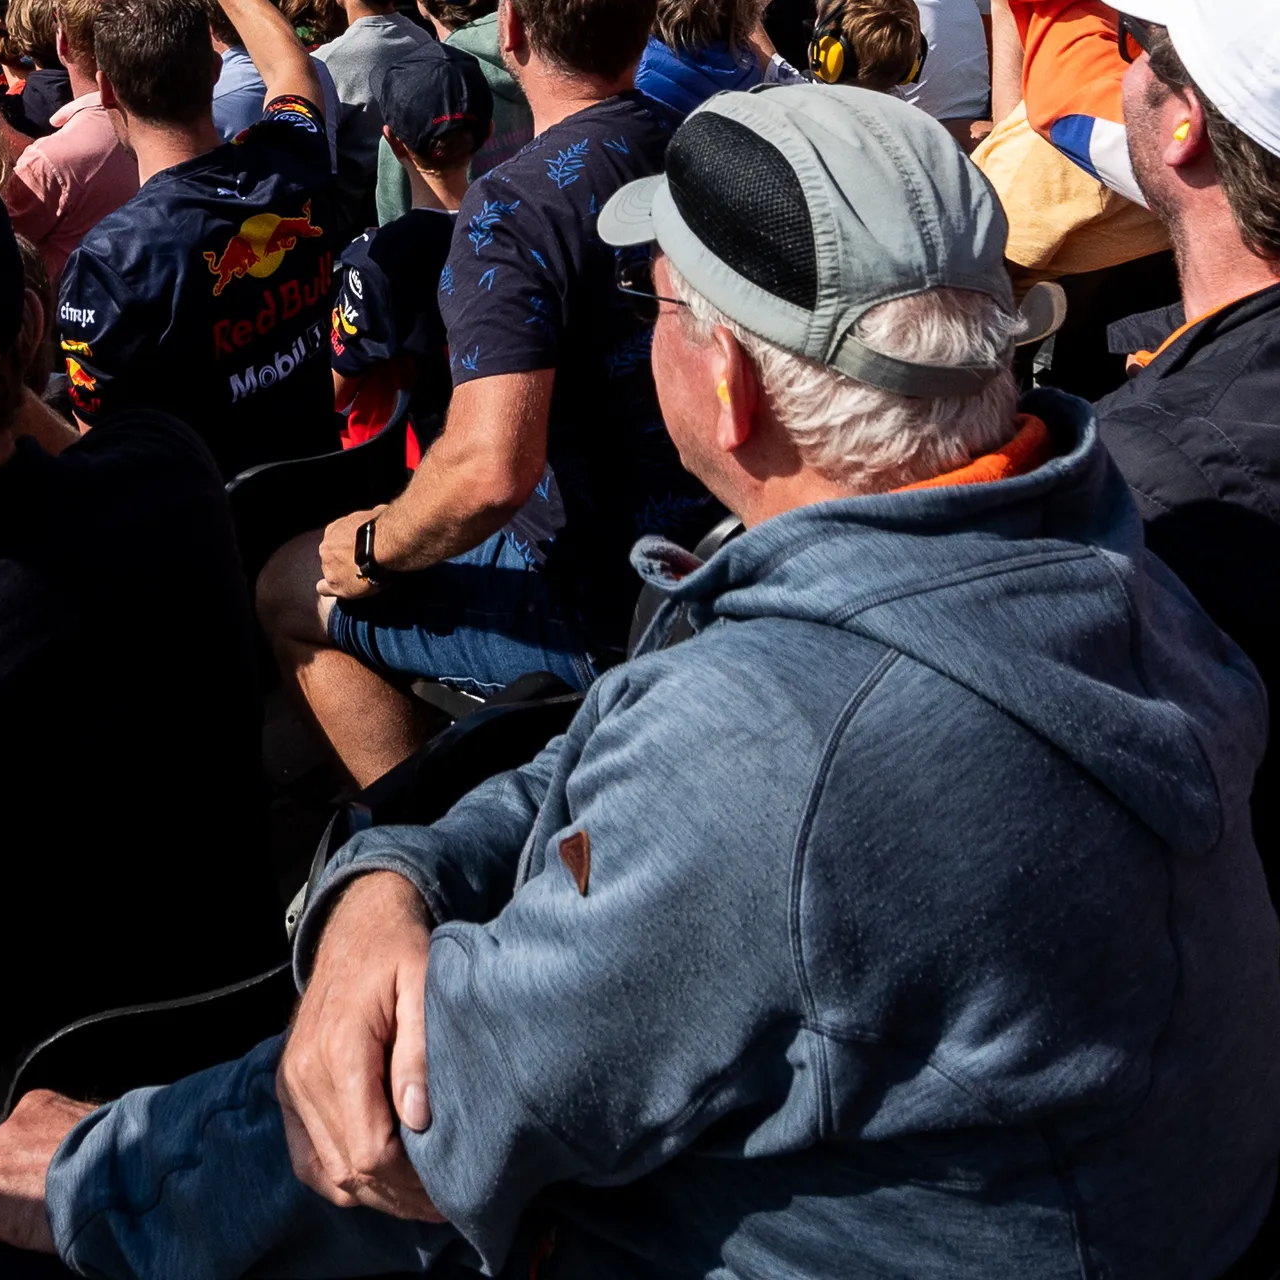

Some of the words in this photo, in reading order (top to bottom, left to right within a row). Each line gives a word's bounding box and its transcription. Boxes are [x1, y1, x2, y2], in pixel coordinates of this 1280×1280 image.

[211, 288, 277, 363] Red
[279, 250, 333, 322] Bull
[229, 336, 307, 405] Mobil
